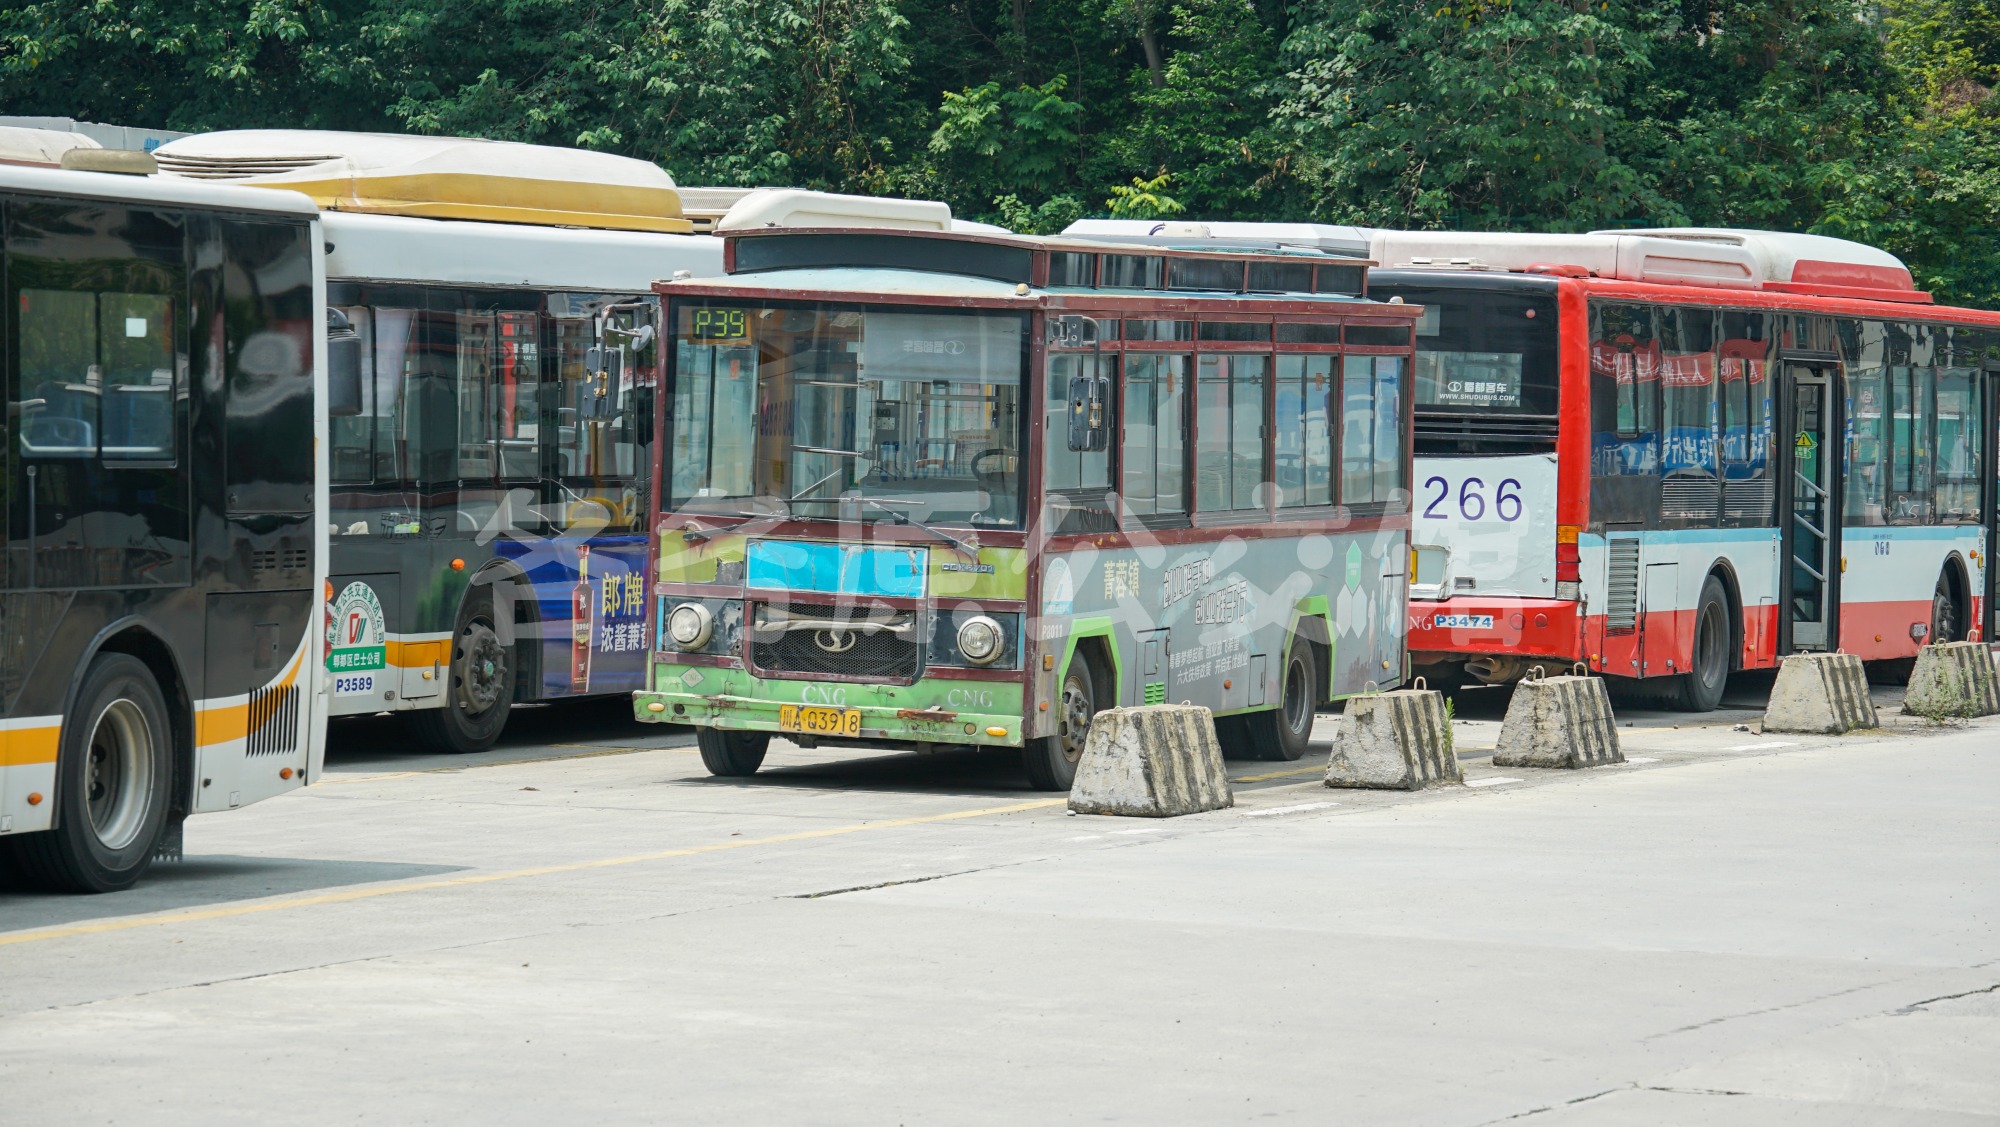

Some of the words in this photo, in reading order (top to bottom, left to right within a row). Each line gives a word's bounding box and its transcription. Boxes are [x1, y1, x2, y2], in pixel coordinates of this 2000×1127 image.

[695, 310, 746, 337] P39
[1439, 393, 1516, 402] WWW.SHUDUBUS.COM
[1464, 381, 1508, 394] 蜀都客车
[1422, 475, 1523, 522] 266
[1103, 558, 1140, 600] 菁蓉镇
[601, 570, 644, 618] 郎牌
[1195, 579, 1248, 625] 创业践于行
[1408, 615, 1432, 631] NG
[1436, 616, 1492, 628] P3474
[336, 676, 373, 692] P3589
[801, 685, 847, 705] CNG
[947, 688, 994, 708] CNG
